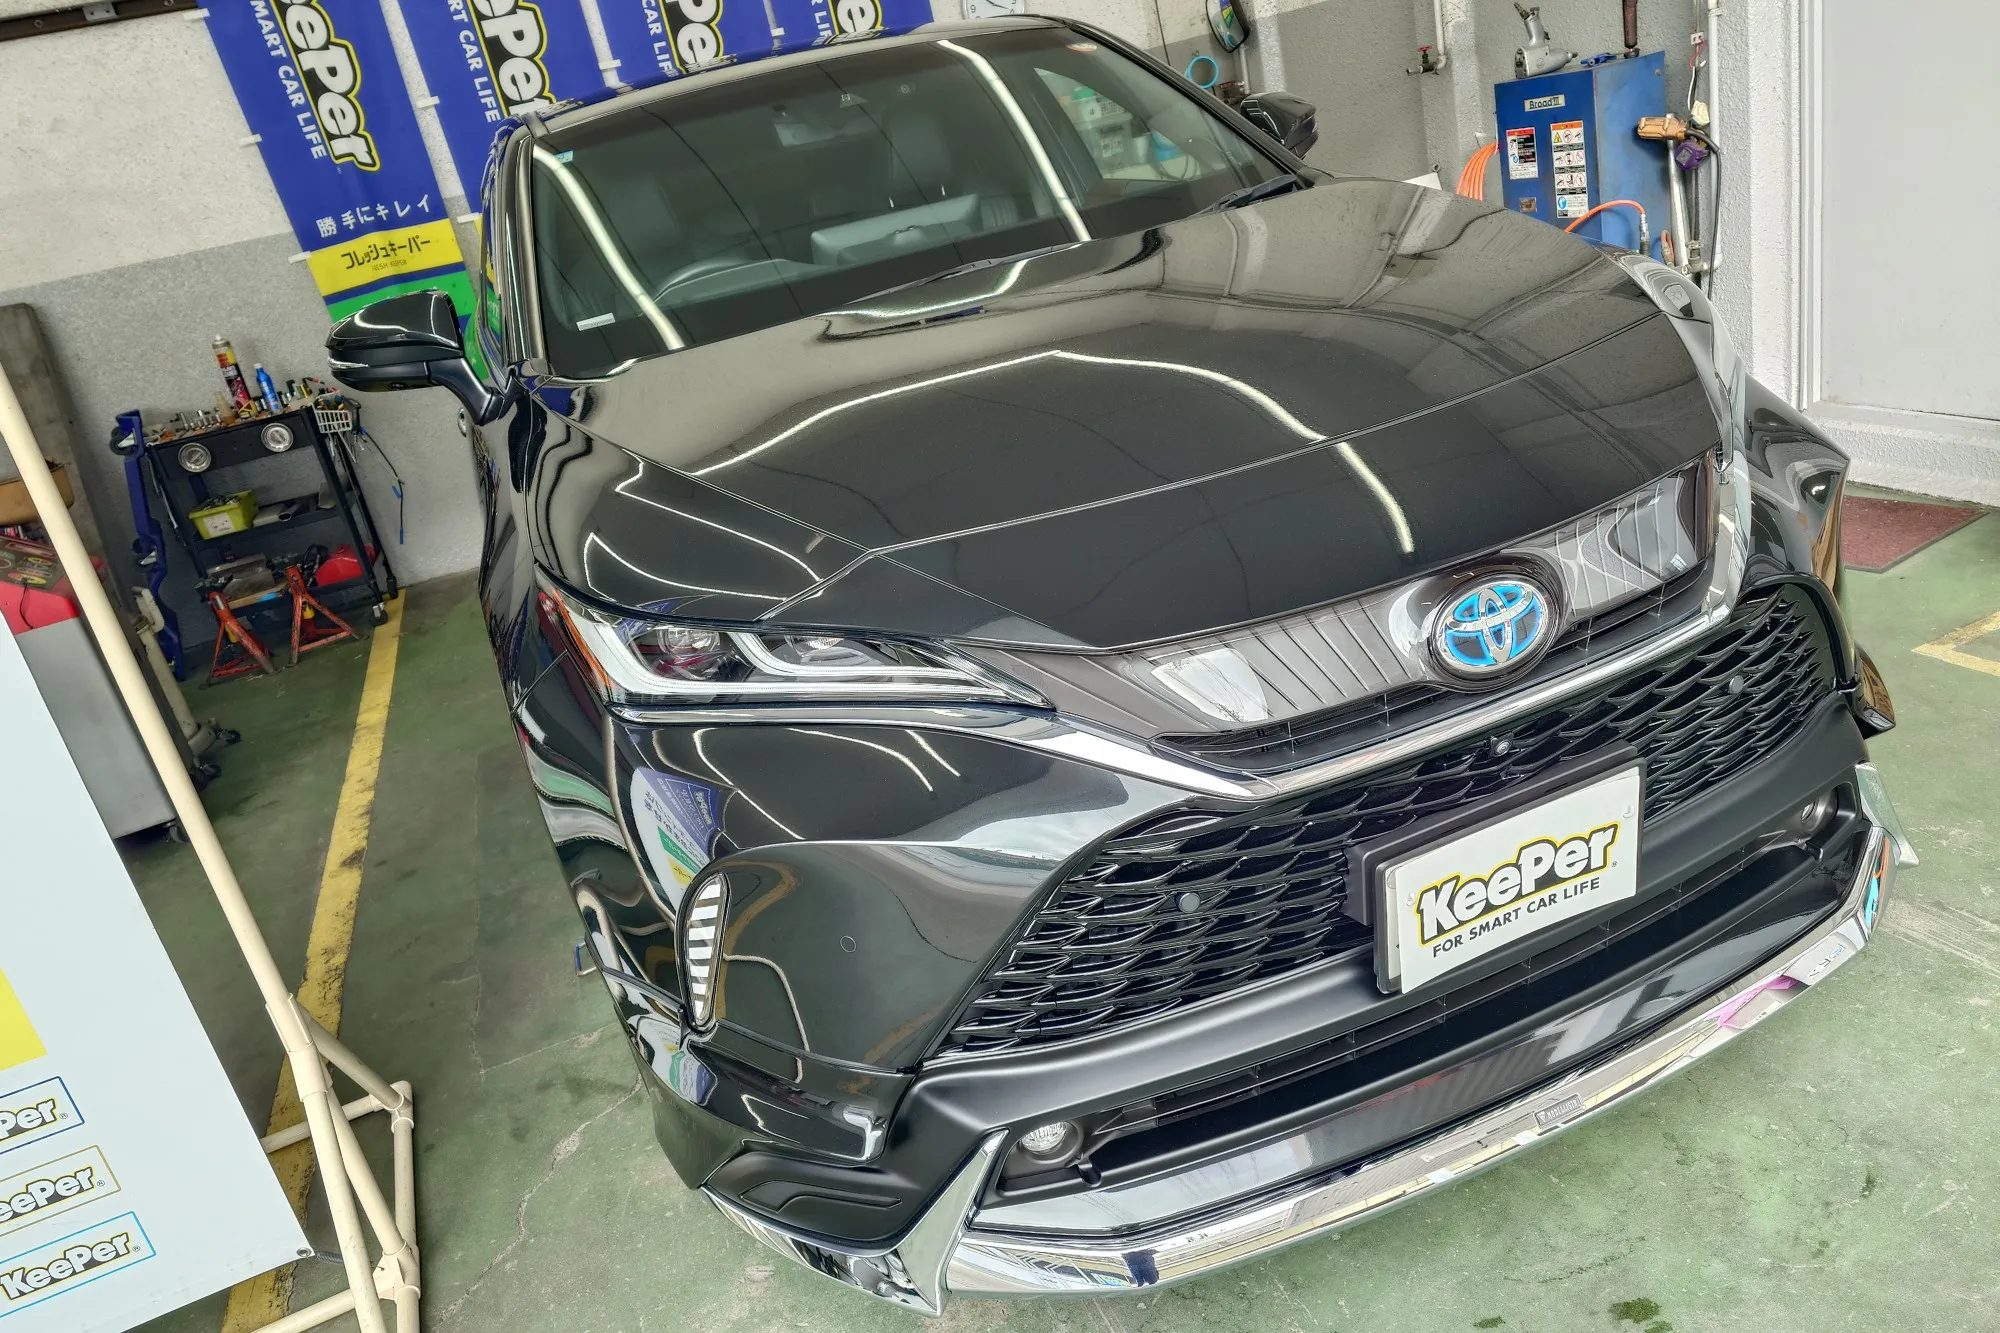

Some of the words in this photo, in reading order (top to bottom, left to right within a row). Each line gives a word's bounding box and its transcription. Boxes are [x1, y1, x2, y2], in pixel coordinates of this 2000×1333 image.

[276, 0, 376, 167] ePer
[278, 65, 305, 108] CAR
[296, 111, 328, 159] LIFE
[459, 29, 483, 72] CAR
[473, 76, 502, 123] LIFE
[1416, 823, 1618, 945] KeePer
[1432, 934, 1463, 957] FOR
[1469, 907, 1522, 940] SMART
[1526, 894, 1558, 914] CAR
[1563, 877, 1600, 900] LIFE
[0, 1232, 131, 1300] KeePer
